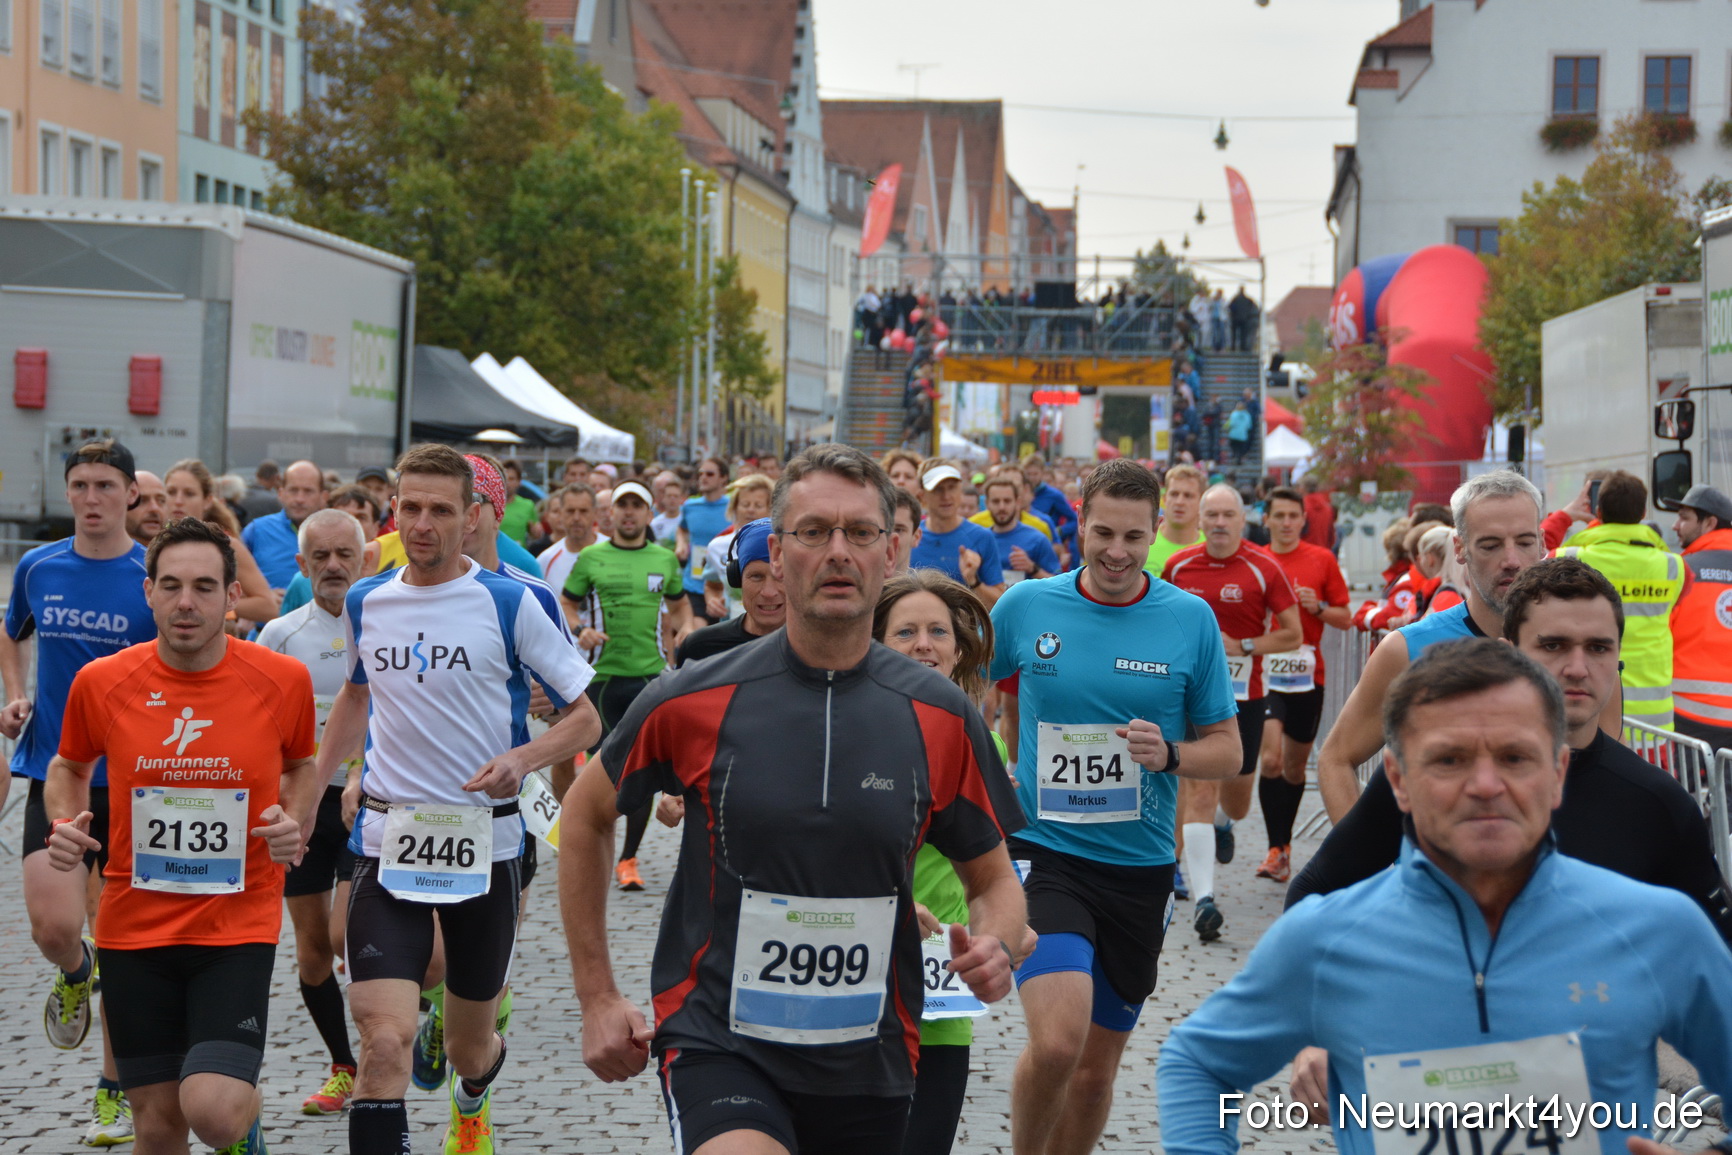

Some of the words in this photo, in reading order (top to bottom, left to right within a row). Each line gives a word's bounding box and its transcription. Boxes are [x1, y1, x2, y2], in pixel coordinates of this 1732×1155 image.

[1031, 360, 1081, 383] ZIEL
[42, 606, 129, 633] SYSCAD
[374, 637, 472, 678] SUSPA
[1032, 662, 1058, 672] PARTL
[1115, 657, 1171, 675] BOCK
[1270, 658, 1307, 673] 2266
[1071, 732, 1108, 743] BOCK
[135, 755, 230, 772] funrunners
[1051, 753, 1124, 784] 2154
[162, 767, 244, 781] neumarkt
[175, 797, 215, 808] BOCK
[1068, 794, 1107, 806] Markus
[424, 813, 463, 824] BOCK
[148, 819, 228, 852] 2133
[397, 834, 475, 868] 2446
[165, 861, 209, 875] Michael
[415, 875, 455, 888] Werner
[802, 911, 856, 925] BOCK
[759, 940, 869, 987] 2999
[742, 973, 749, 982] D
[237, 1022, 261, 1034] adidas
[1444, 1061, 1518, 1086] BOCK
